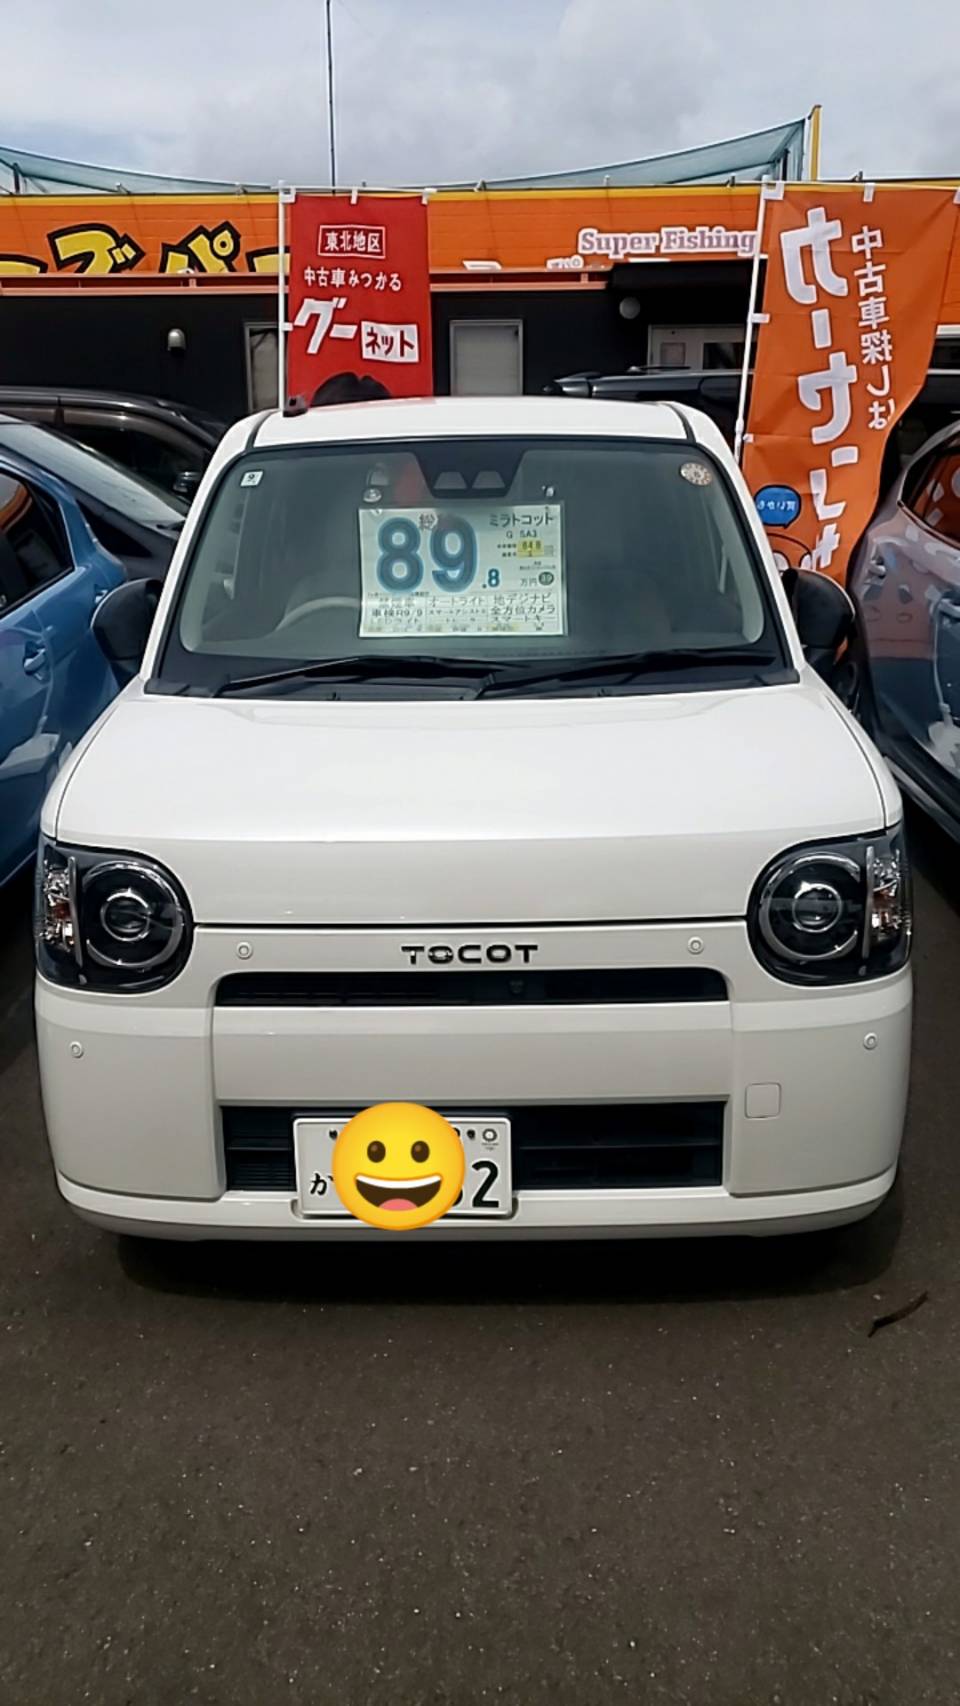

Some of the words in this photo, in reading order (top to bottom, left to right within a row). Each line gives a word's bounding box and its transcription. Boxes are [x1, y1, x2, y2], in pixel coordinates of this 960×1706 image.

[324, 230, 381, 253] 東北地区
[580, 229, 657, 257] Super
[661, 228, 757, 254] Fishing
[303, 266, 402, 292] 中古車みつかる
[293, 296, 358, 355] グー
[364, 325, 416, 358] ネット
[489, 513, 554, 526] ミラトコット
[494, 591, 551, 605] 地デジナビ
[401, 944, 538, 965] TOCOT
